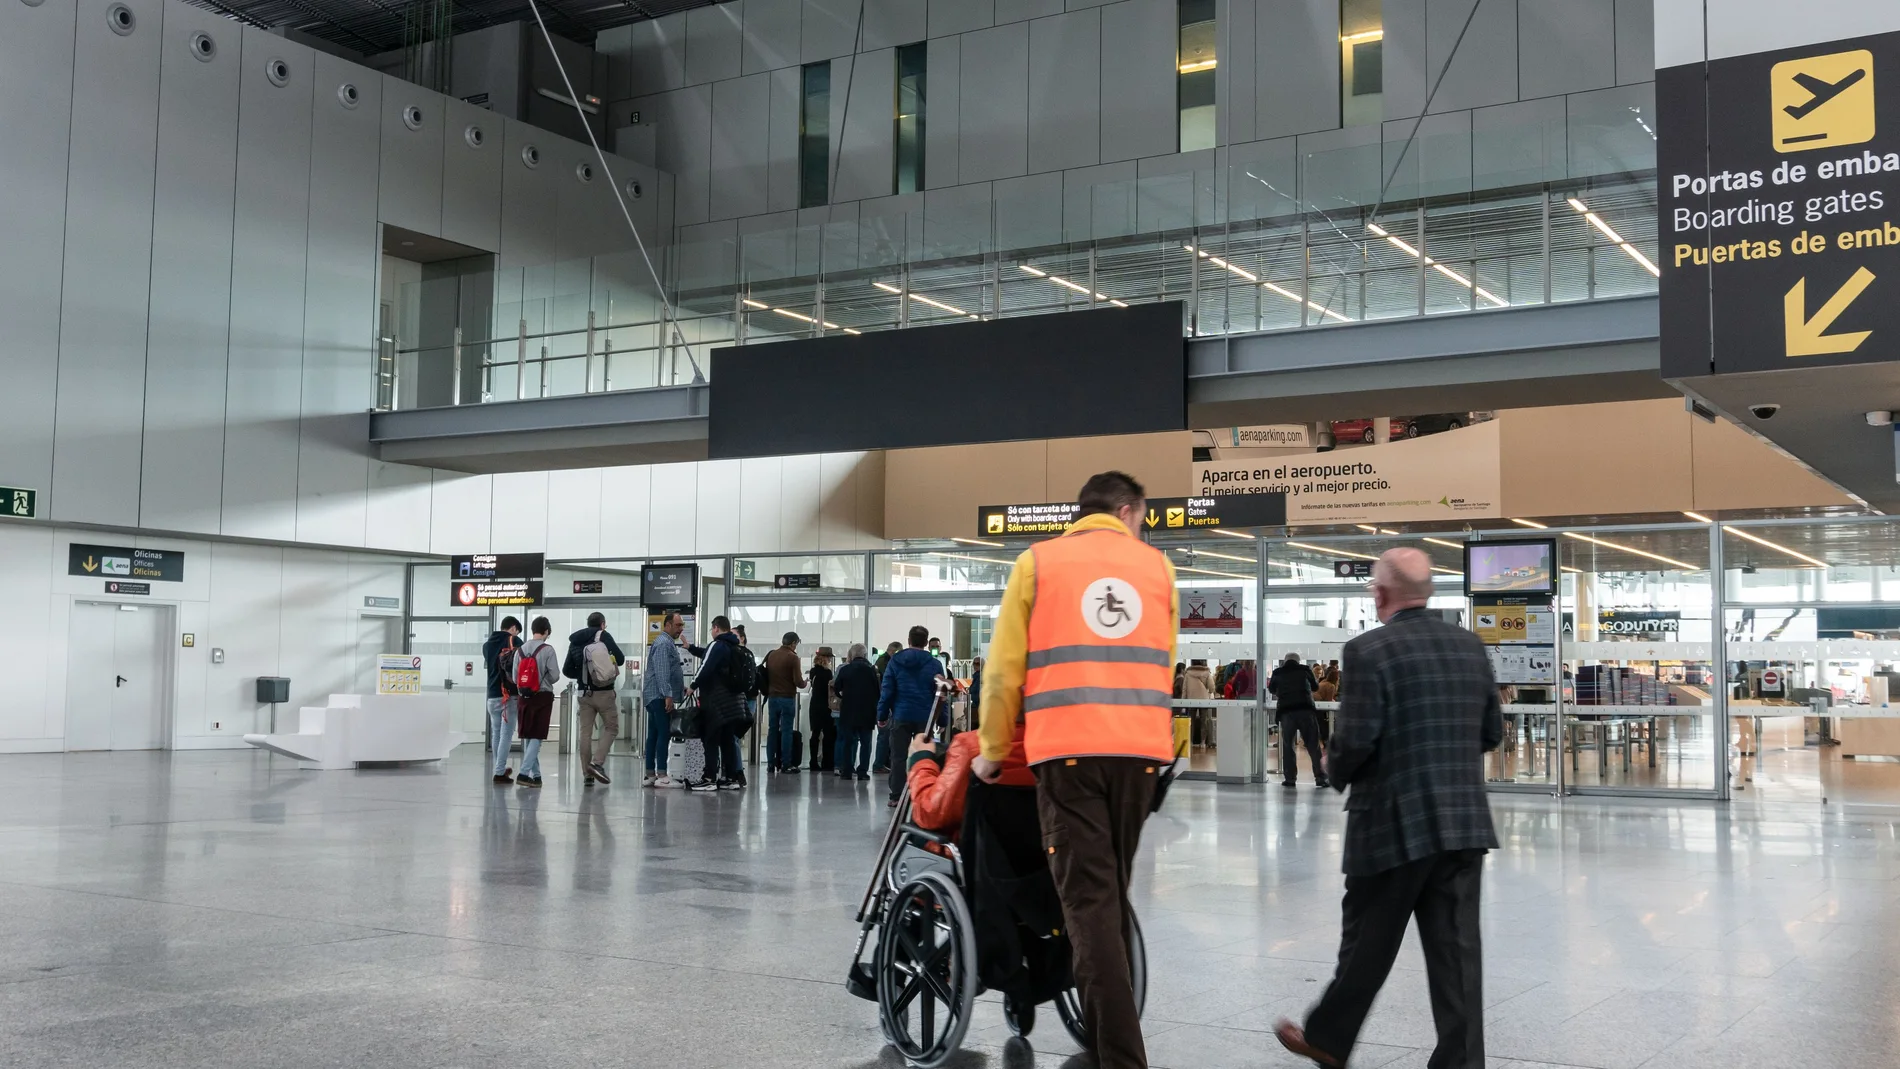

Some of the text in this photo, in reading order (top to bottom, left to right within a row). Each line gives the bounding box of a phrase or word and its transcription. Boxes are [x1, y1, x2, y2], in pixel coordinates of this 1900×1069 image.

[1672, 150, 1900, 198] Portas de emba
[1673, 189, 1884, 232] Boarding gates
[1674, 221, 1900, 268] Puertas de emb
[1239, 428, 1303, 444] aenaparking.com
[1201, 461, 1377, 486] Aparca en el aeropuerto.
[1248, 482, 1291, 495] servicio
[1293, 484, 1301, 496] y
[1303, 482, 1314, 493] al
[1316, 480, 1350, 494] mejor
[1352, 478, 1391, 493] precio.
[1187, 498, 1216, 508] Portas
[1386, 499, 1432, 507] aenaparking.com
[1007, 505, 1018, 515] Só
[1032, 504, 1061, 514] tarxeta
[1060, 503, 1071, 513] de
[1187, 507, 1207, 516] Gates
[1007, 512, 1072, 524] Only with boarding card
[1188, 516, 1220, 526] Puertas
[1007, 523, 1023, 532] Sólo
[1023, 524, 1037, 532] con
[1037, 522, 1063, 532] tarjeta
[134, 549, 163, 560] Oficinas
[472, 554, 497, 563] Consigna
[133, 559, 155, 568] Offices
[133, 567, 162, 577] Oficinas
[472, 569, 496, 577] Consigna
[502, 582, 529, 591] autorizado
[476, 597, 488, 605] Sólo
[509, 596, 535, 605] autorizado
[186, 636, 192, 645] C
